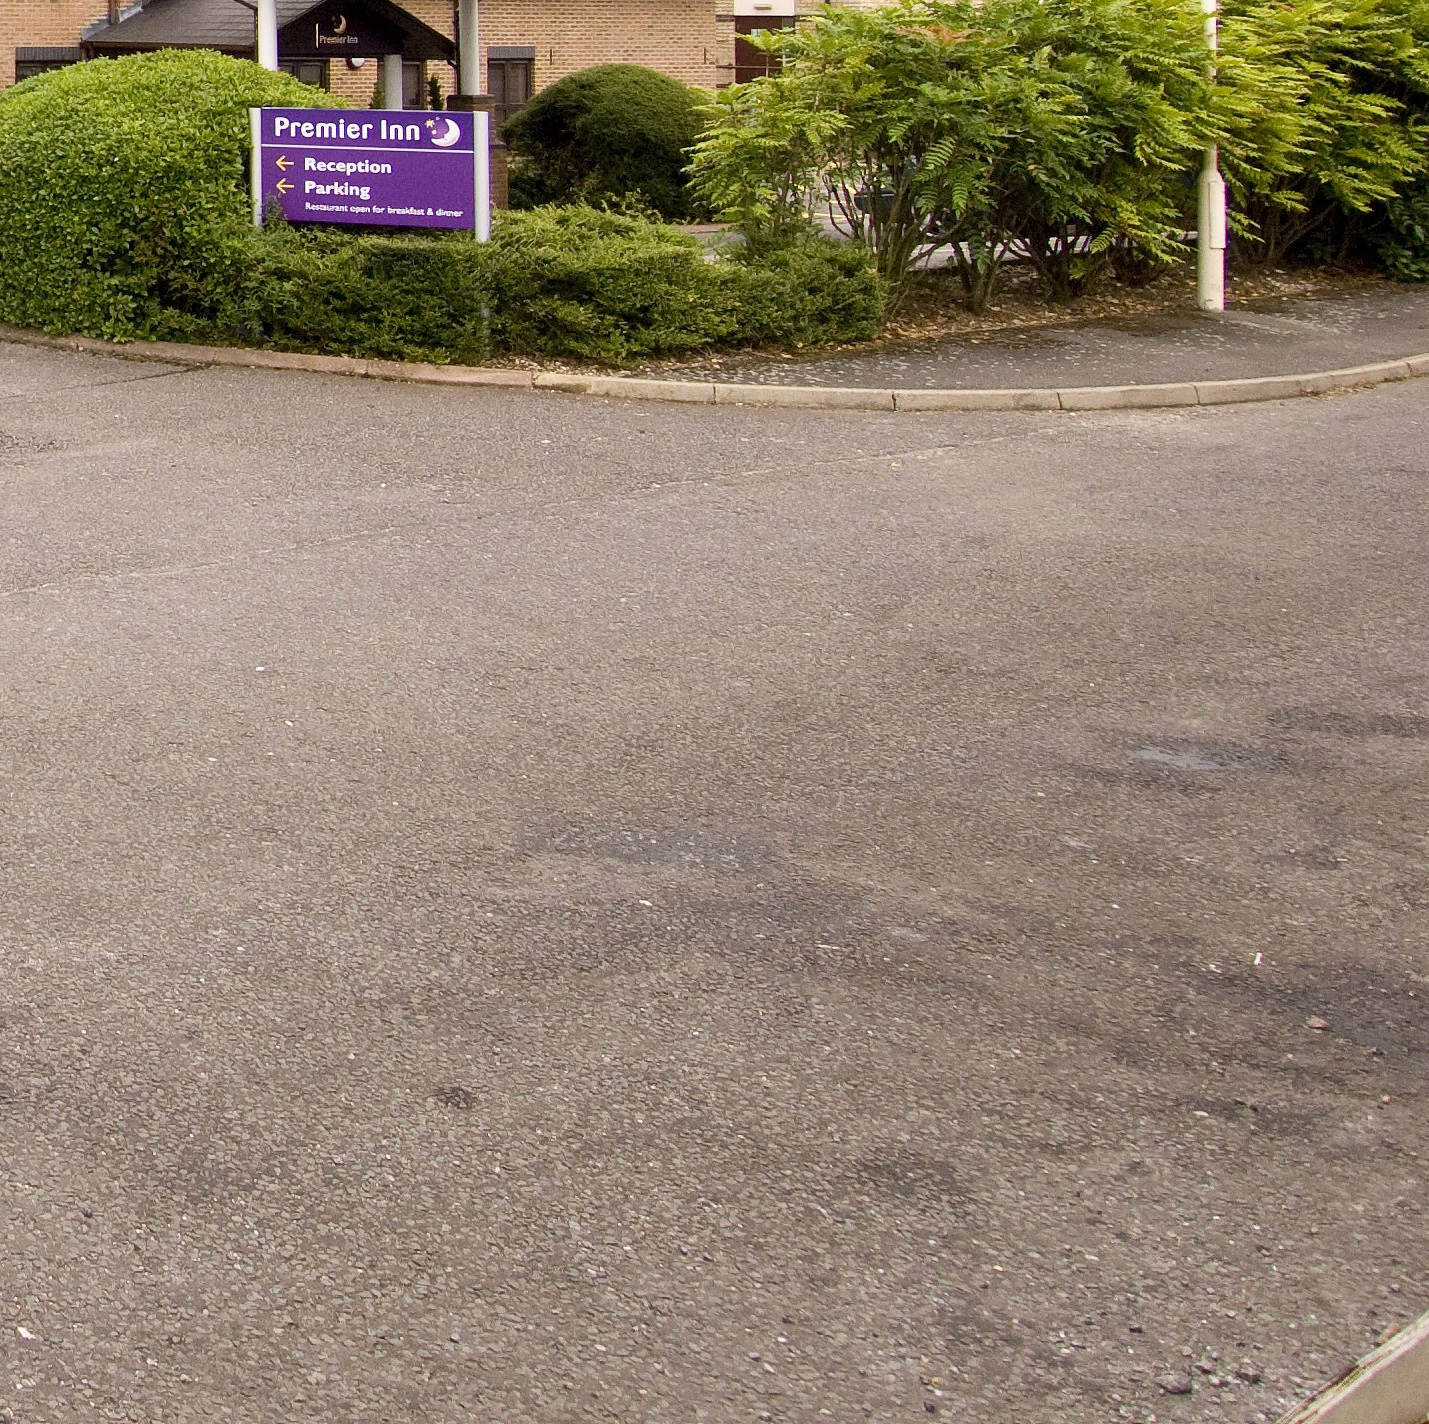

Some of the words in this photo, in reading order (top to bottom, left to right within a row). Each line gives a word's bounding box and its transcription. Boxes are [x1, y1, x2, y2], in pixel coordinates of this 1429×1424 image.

[274, 117, 373, 140] Premier
[381, 119, 420, 141] Inn
[304, 157, 392, 176] Reception
[304, 180, 371, 200] Parking
[304, 202, 349, 213] Restaurant
[350, 206, 371, 215] open
[372, 205, 386, 214] for
[387, 206, 425, 216] breakfast
[426, 207, 434, 216] &
[436, 208, 464, 218] dinner
